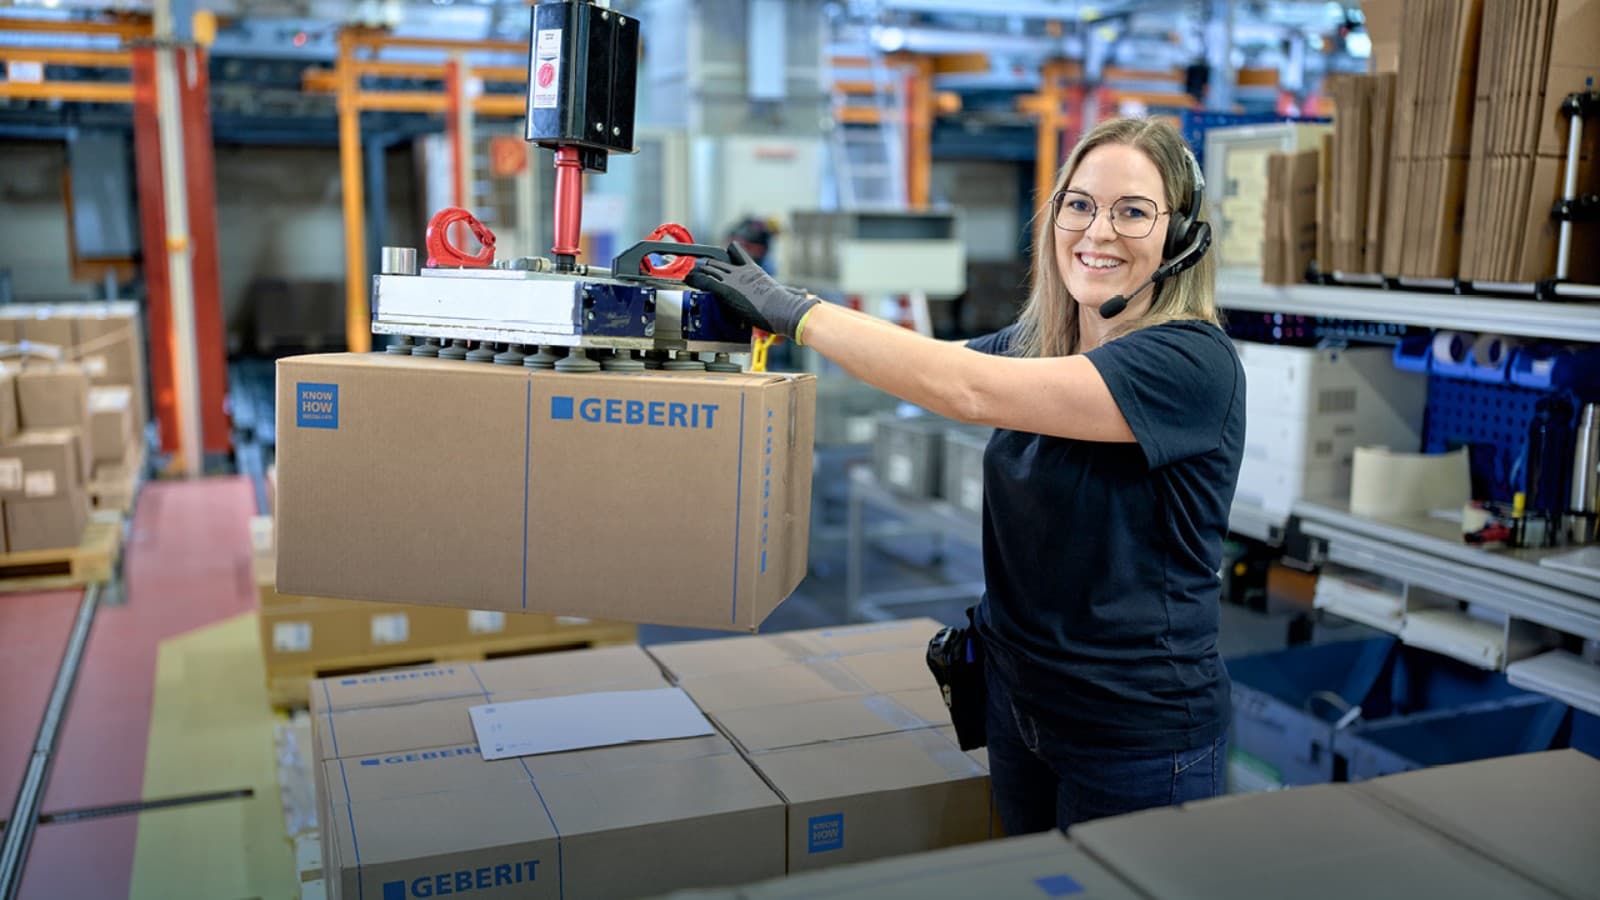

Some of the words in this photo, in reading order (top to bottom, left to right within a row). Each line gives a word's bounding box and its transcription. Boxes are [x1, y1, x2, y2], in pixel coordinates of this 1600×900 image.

[302, 391, 333, 401] KNOW
[302, 401, 333, 413] HOW
[579, 397, 719, 429] GEBERIT
[384, 746, 482, 764] GEBERI
[813, 829, 839, 841] HOW
[410, 859, 541, 899] GEBERIT
